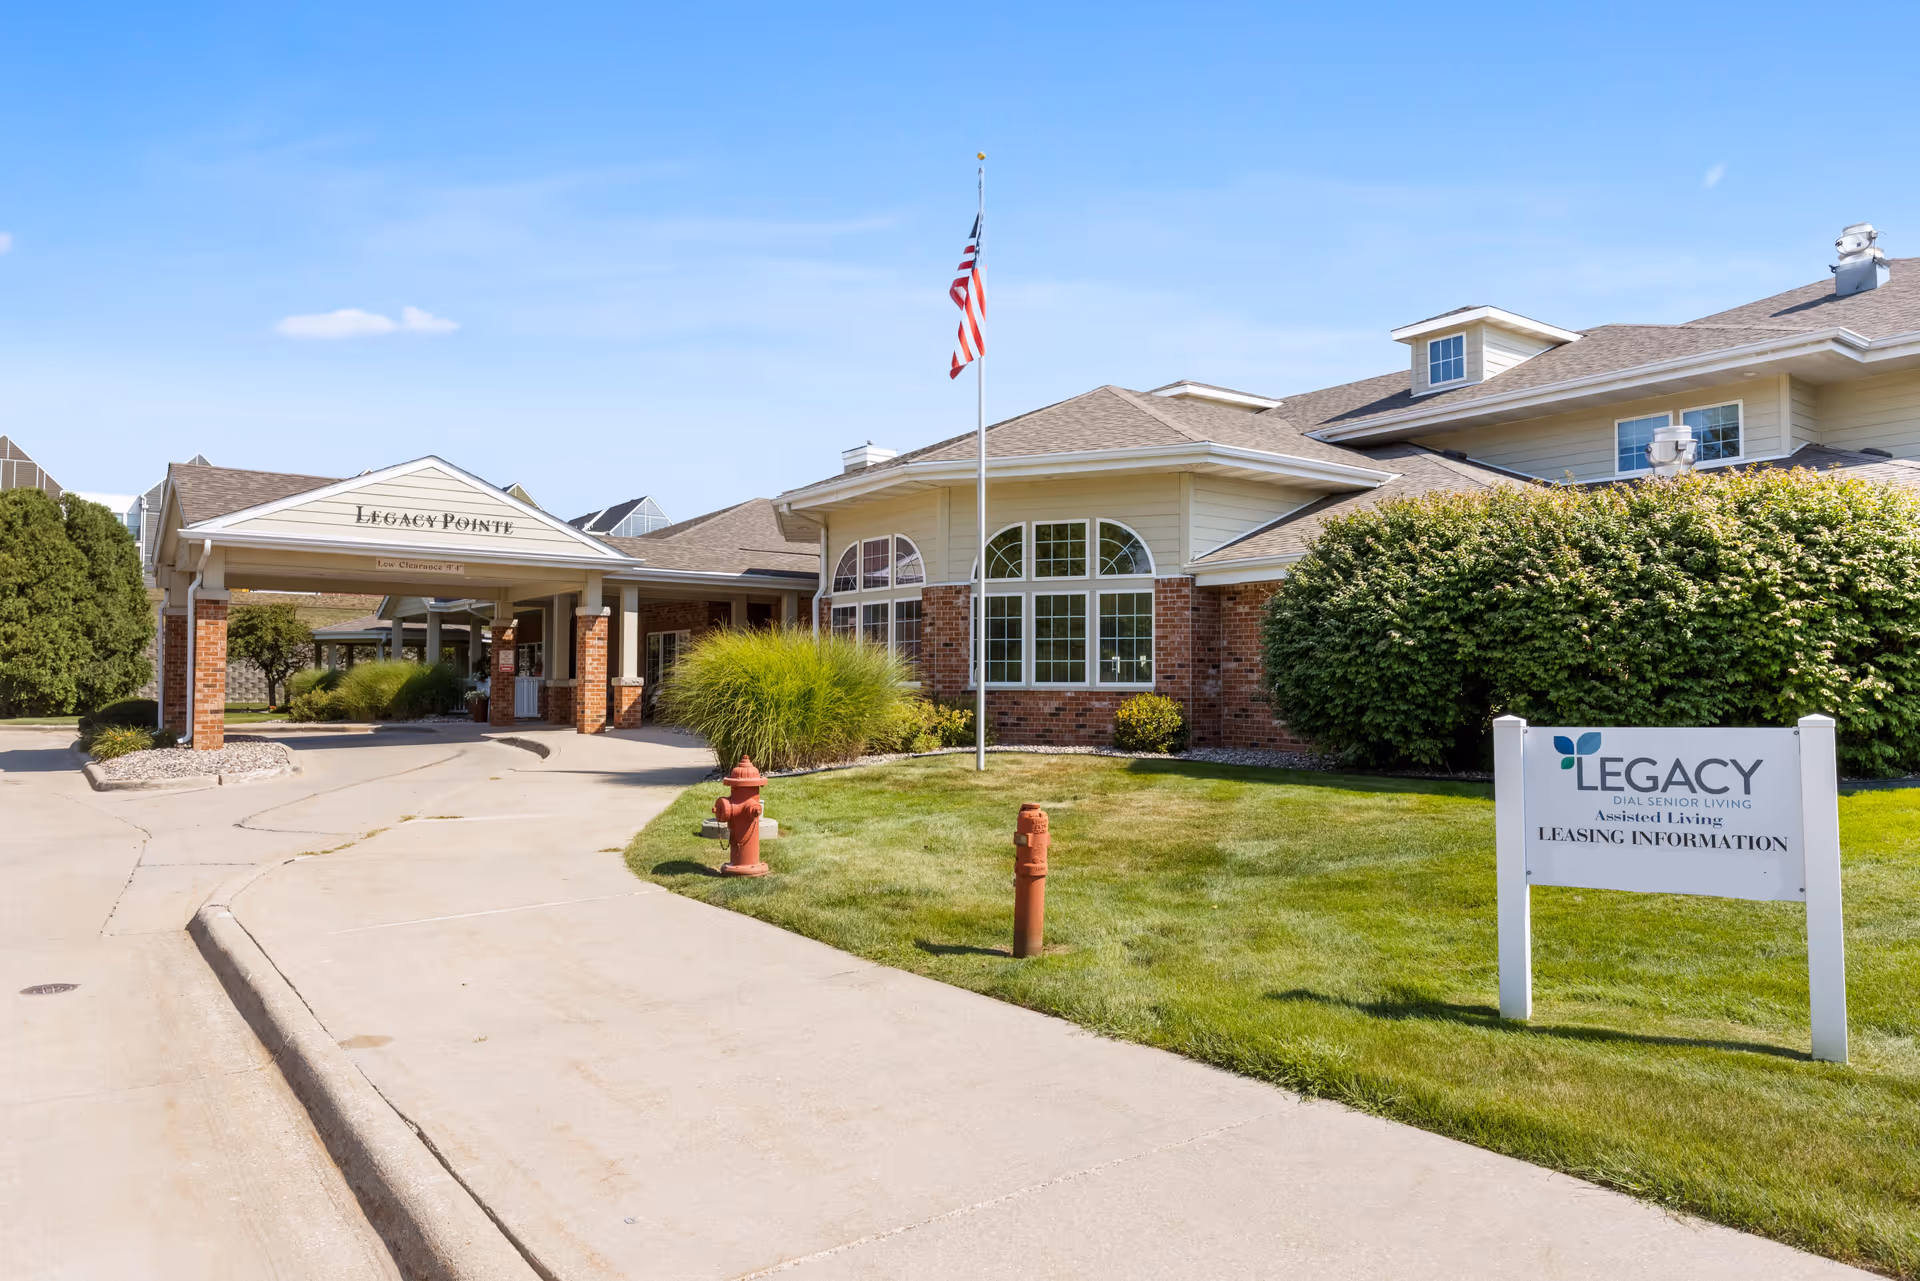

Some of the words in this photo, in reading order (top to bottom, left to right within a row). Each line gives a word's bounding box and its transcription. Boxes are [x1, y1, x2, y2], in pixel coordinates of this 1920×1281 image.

[355, 505, 438, 528] LEGACY
[441, 512, 514, 535] POINTE
[377, 560, 395, 568] Low
[399, 561, 443, 571] Clearance
[1576, 756, 1764, 795] LEGACY
[1613, 795, 1645, 806] DIAL
[1647, 796, 1699, 808] SENIOR
[1704, 798, 1752, 809] LIVING
[1594, 809, 1661, 824] Assisted
[1667, 812, 1723, 828] Living
[1538, 826, 1625, 845] LEASING
[1632, 830, 1789, 852] INFORMATION
